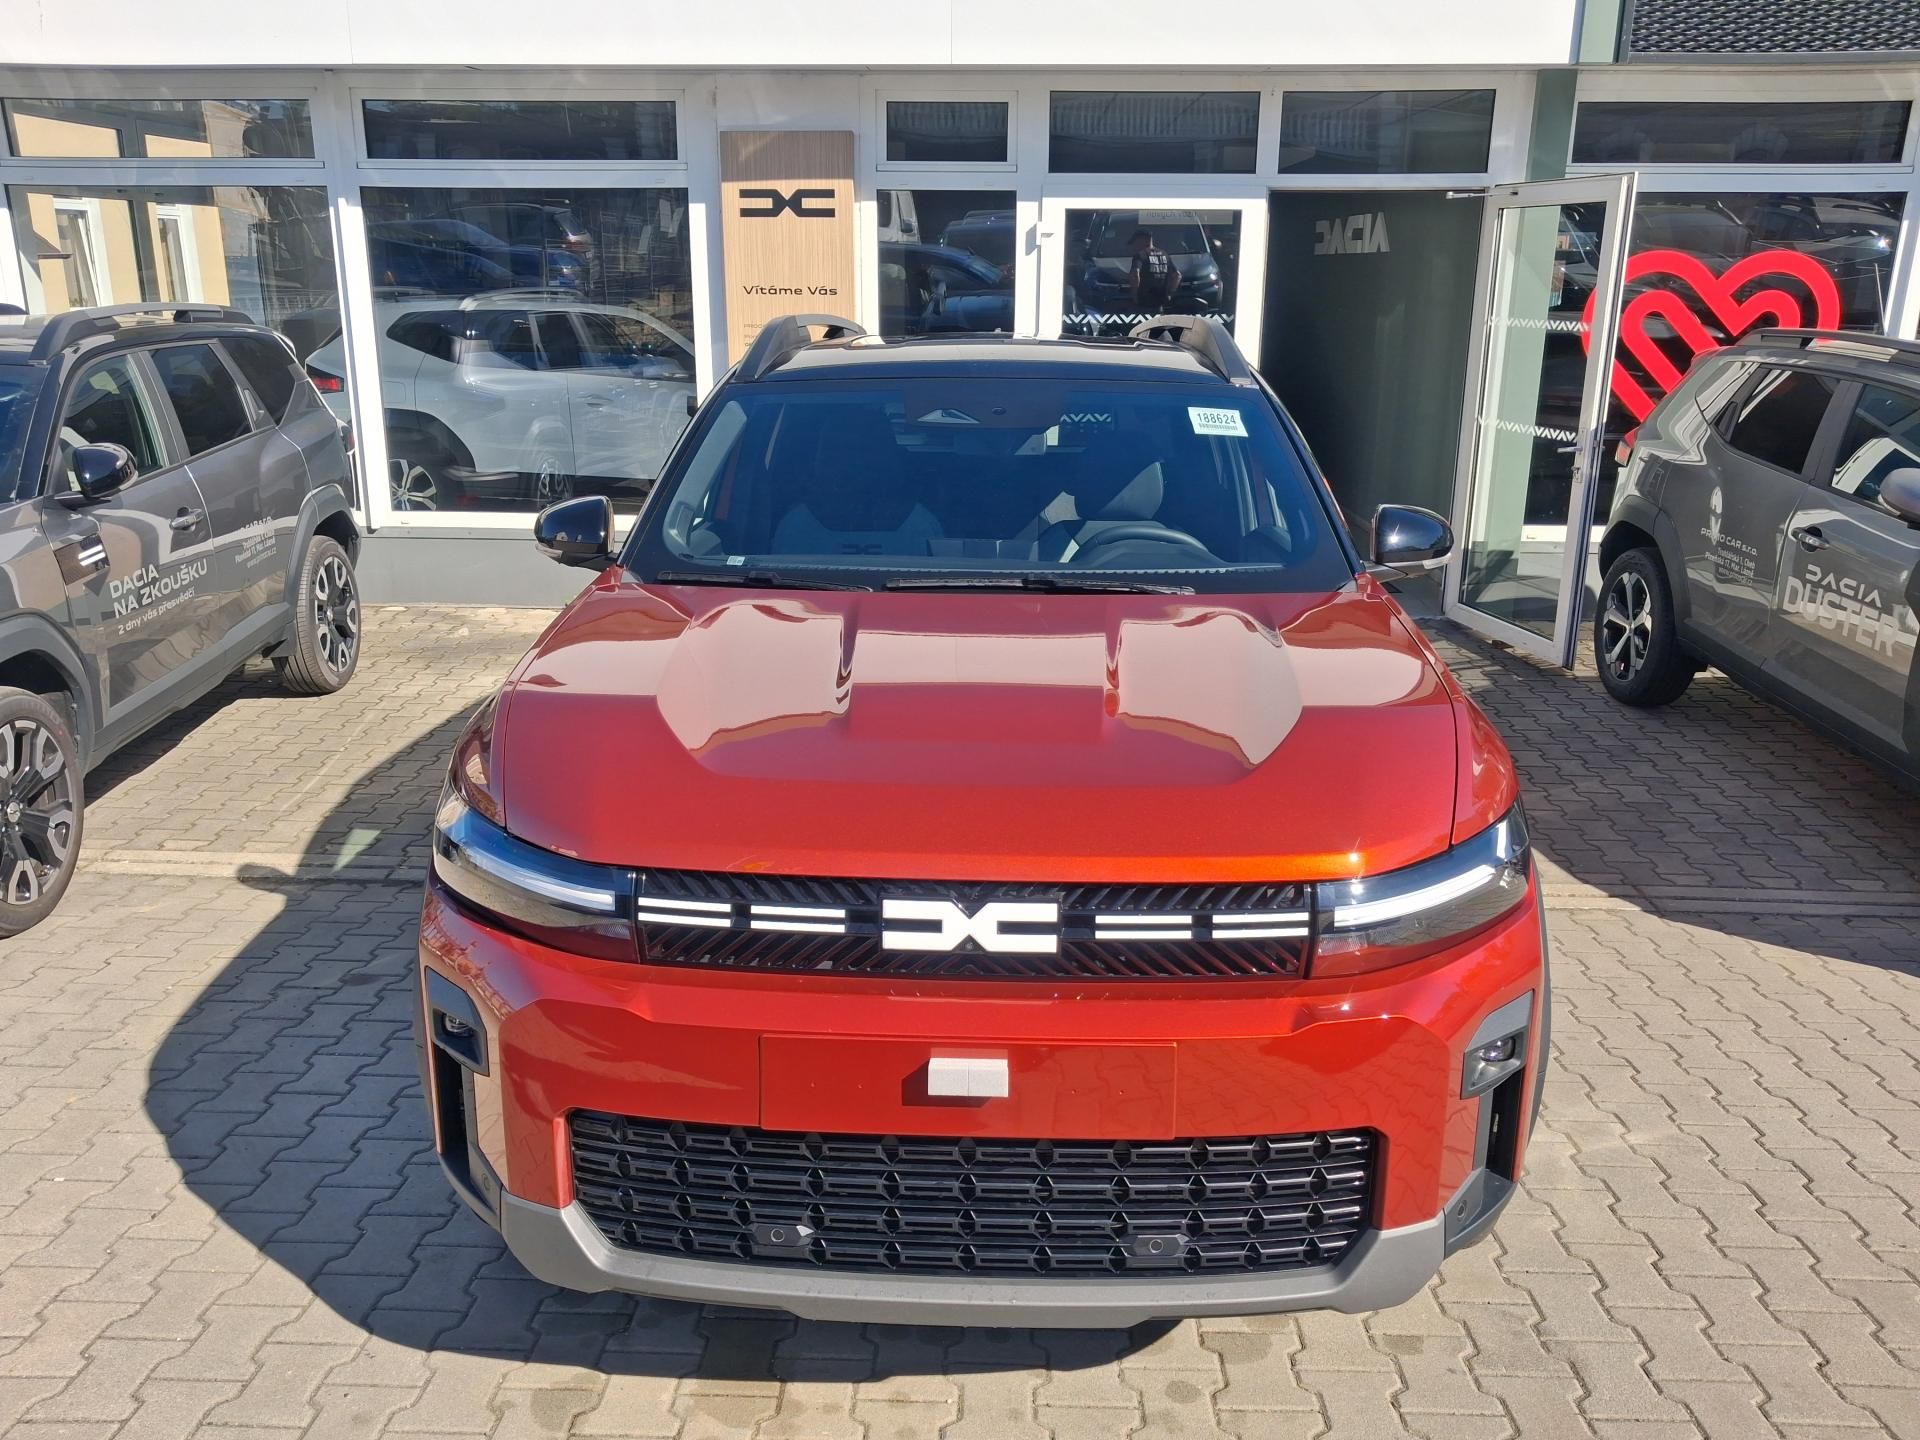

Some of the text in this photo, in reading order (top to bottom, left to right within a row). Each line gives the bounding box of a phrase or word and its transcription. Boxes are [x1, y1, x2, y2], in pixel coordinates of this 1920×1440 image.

[1314, 212, 1390, 255] DACIA
[743, 285, 838, 296] Vítáme Vás
[1197, 412, 1237, 425] 188624
[1726, 536, 1742, 550] CAR
[109, 563, 159, 599] DACIA
[113, 558, 208, 619] NA ZKOUŠKU
[1805, 563, 1882, 608] DACIA
[118, 586, 195, 635] 2 dny vás přesvědčí
[1782, 575, 1900, 657] DUSTER
